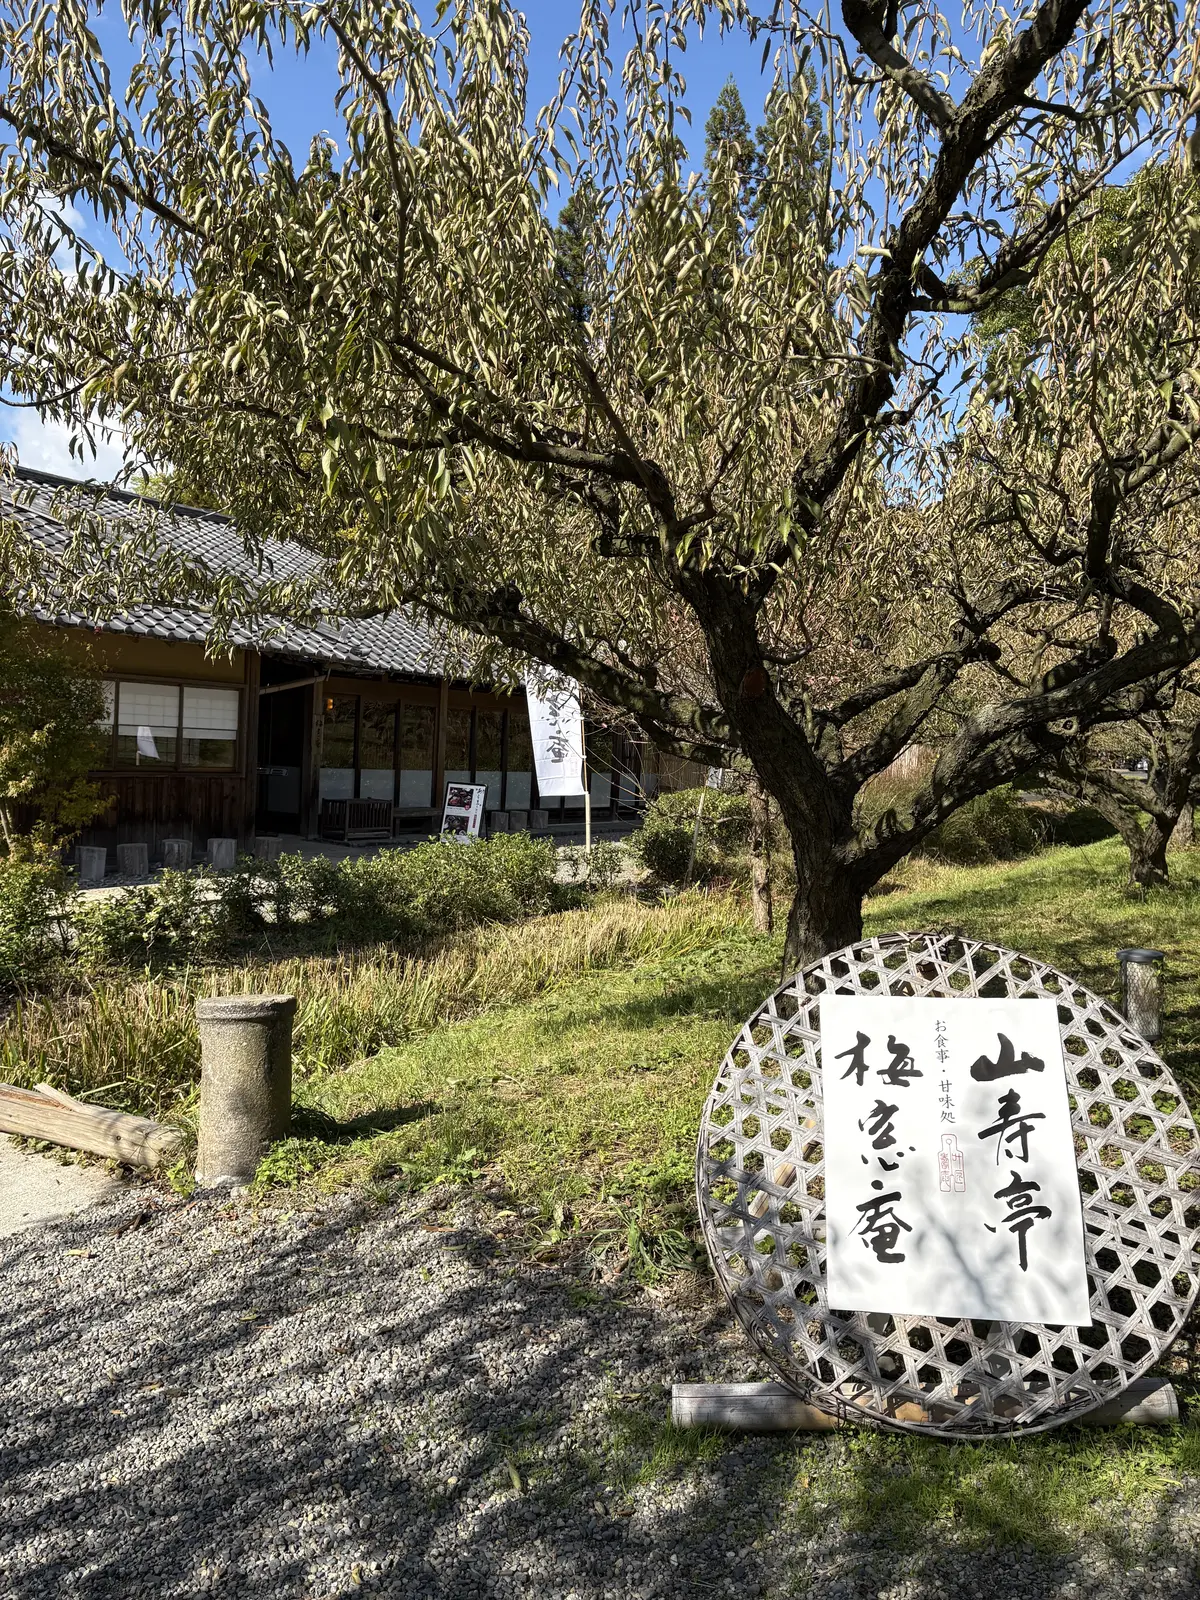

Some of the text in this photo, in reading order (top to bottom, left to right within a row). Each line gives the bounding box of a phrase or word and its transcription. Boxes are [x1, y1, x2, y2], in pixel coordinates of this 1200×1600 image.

[934, 1019, 956, 1124] お食事・甘味処
[970, 1032, 1052, 1272] 山寿亭
